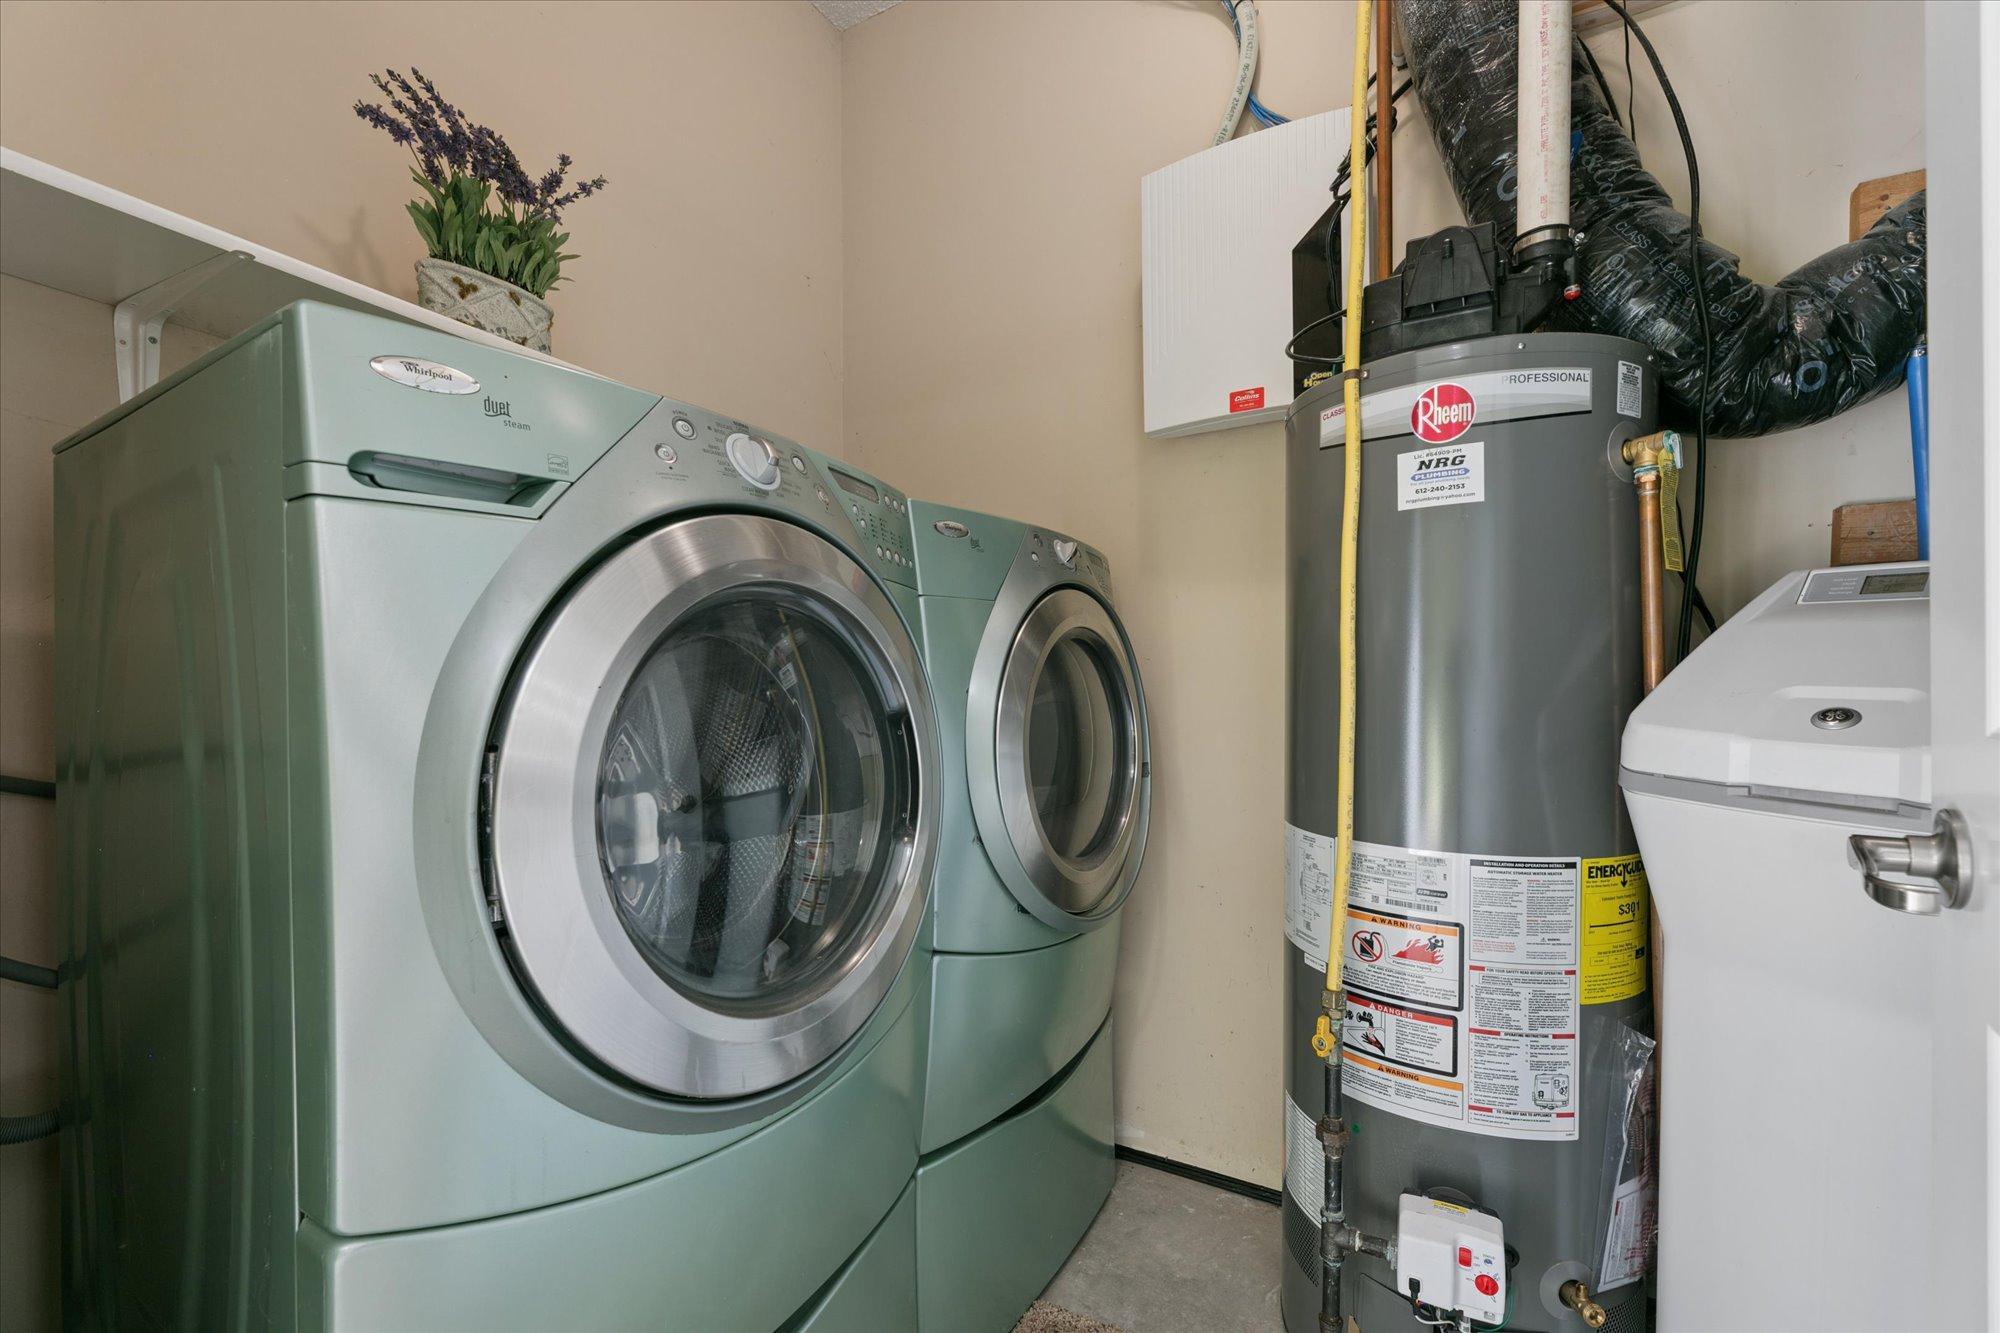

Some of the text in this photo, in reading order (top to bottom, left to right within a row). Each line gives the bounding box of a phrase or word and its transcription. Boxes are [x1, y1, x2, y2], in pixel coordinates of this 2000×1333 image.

[1615, 222, 1651, 249] CLASS
[400, 361, 452, 381] Whirlpool
[1311, 371, 1333, 380] Open
[1502, 372, 1589, 385] PROFESSIONAL
[484, 396, 511, 417] duet
[1418, 386, 1472, 434] Rheem
[503, 420, 531, 431] steam
[1417, 455, 1466, 471] NRG
[1414, 468, 1465, 480] PLUMBING
[1415, 483, 1466, 494] 612-240-2153
[1379, 917, 1422, 931] WARNING
[1377, 1005, 1413, 1019] DANGER
[1385, 1066, 1419, 1081] WARNING
